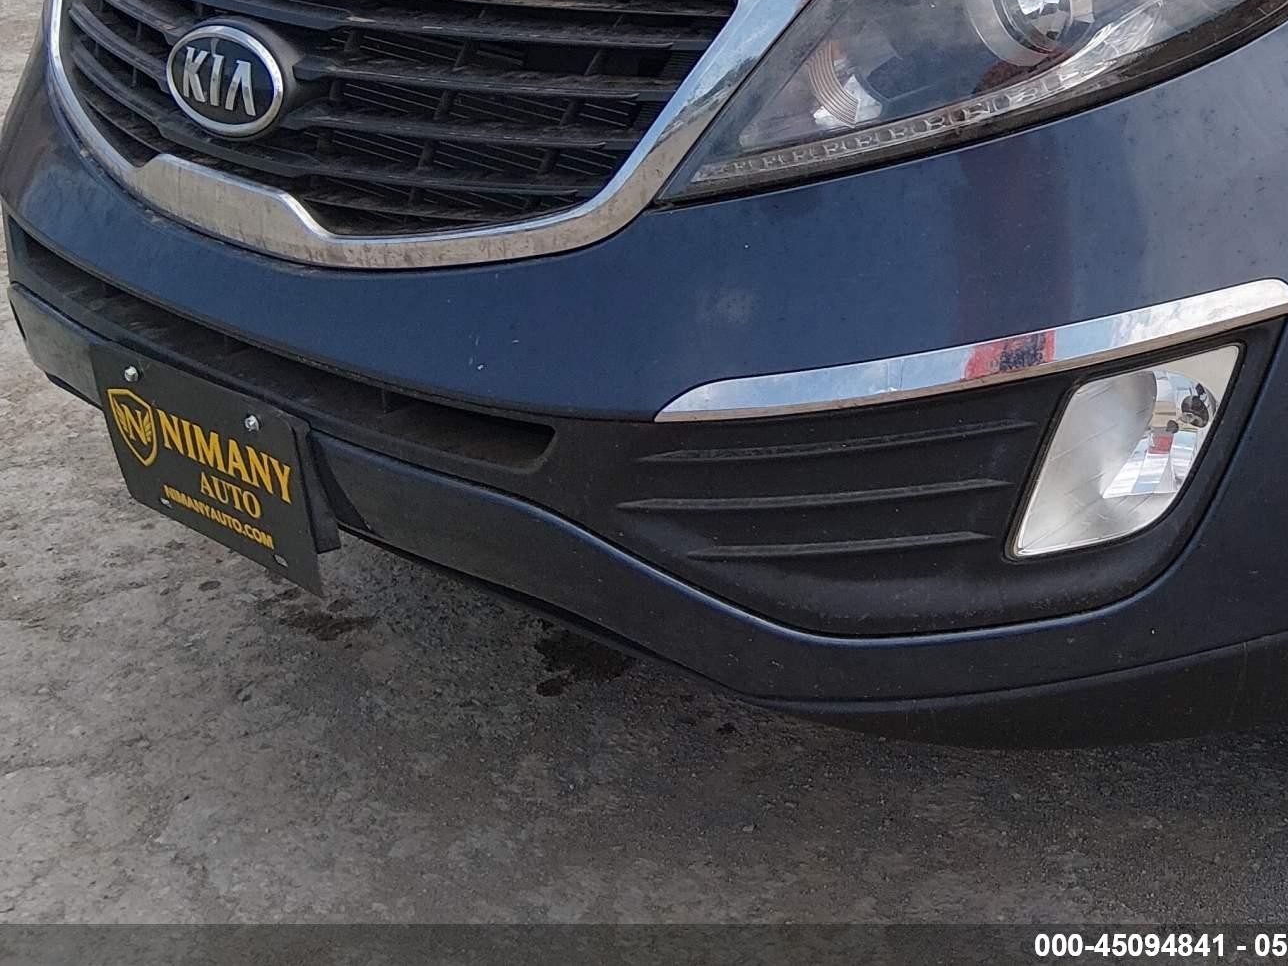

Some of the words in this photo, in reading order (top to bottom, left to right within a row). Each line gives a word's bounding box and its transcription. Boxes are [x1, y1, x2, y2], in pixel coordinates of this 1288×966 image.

[182, 46, 257, 117] KIA
[155, 408, 293, 505] NIMANY
[163, 484, 275, 551] NIMANYAUTO.COM
[200, 471, 262, 520] AUTO
